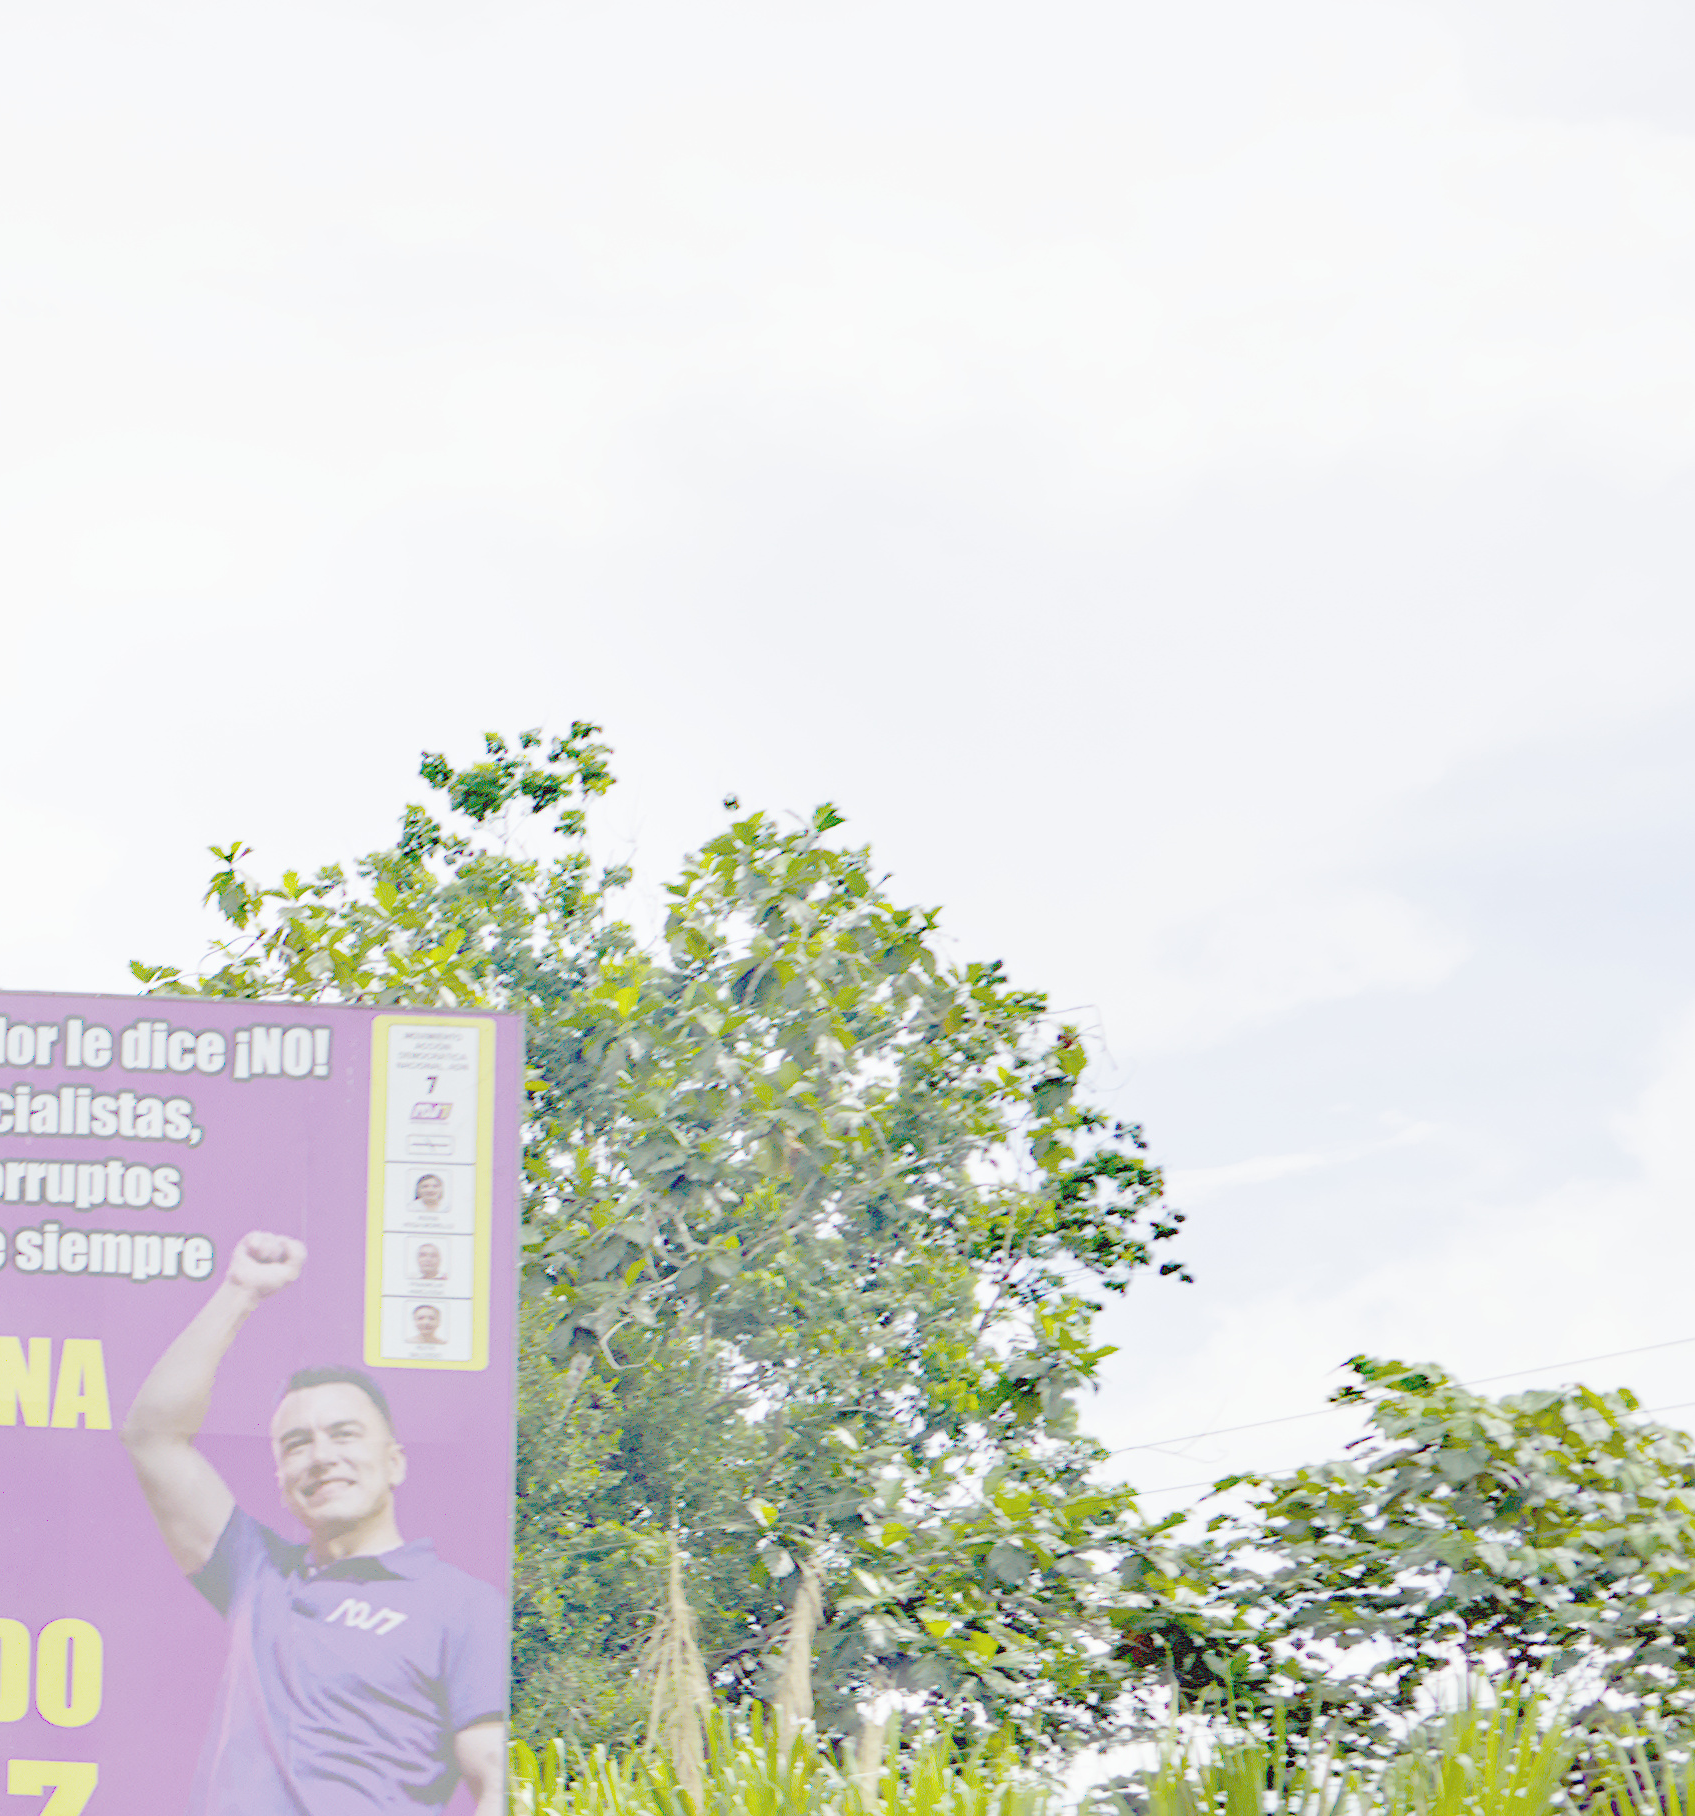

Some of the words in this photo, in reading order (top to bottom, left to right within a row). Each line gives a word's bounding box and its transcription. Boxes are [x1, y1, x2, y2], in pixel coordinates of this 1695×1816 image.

[66, 1019, 112, 1067] le
[122, 1022, 225, 1072] dice
[234, 1027, 330, 1078] ¡NO!
[425, 1074, 440, 1096] 7
[16, 1224, 212, 1279] siempre
